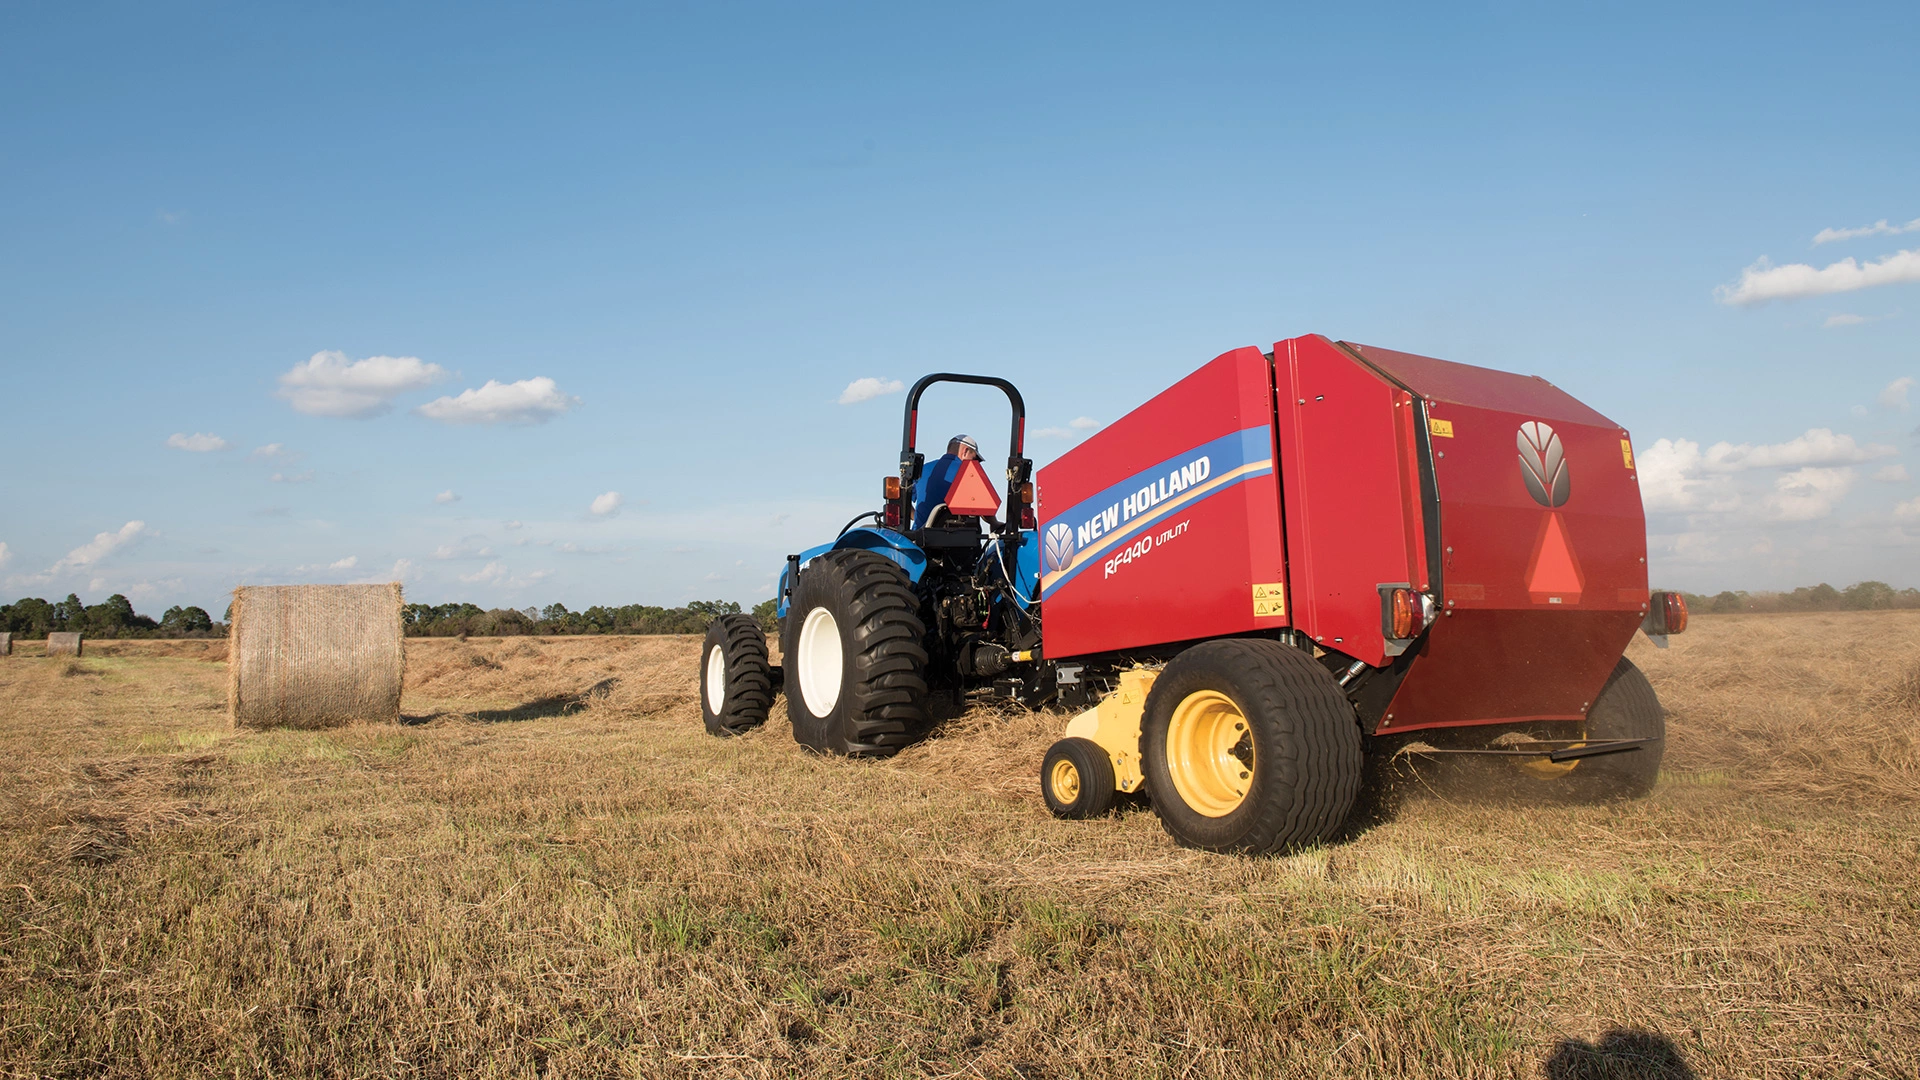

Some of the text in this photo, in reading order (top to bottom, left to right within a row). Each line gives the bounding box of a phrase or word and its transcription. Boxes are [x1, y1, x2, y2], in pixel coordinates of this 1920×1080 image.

[1077, 455, 1211, 549] NEW HOLLAND
[1104, 519, 1191, 579] RF440 UTILITY
